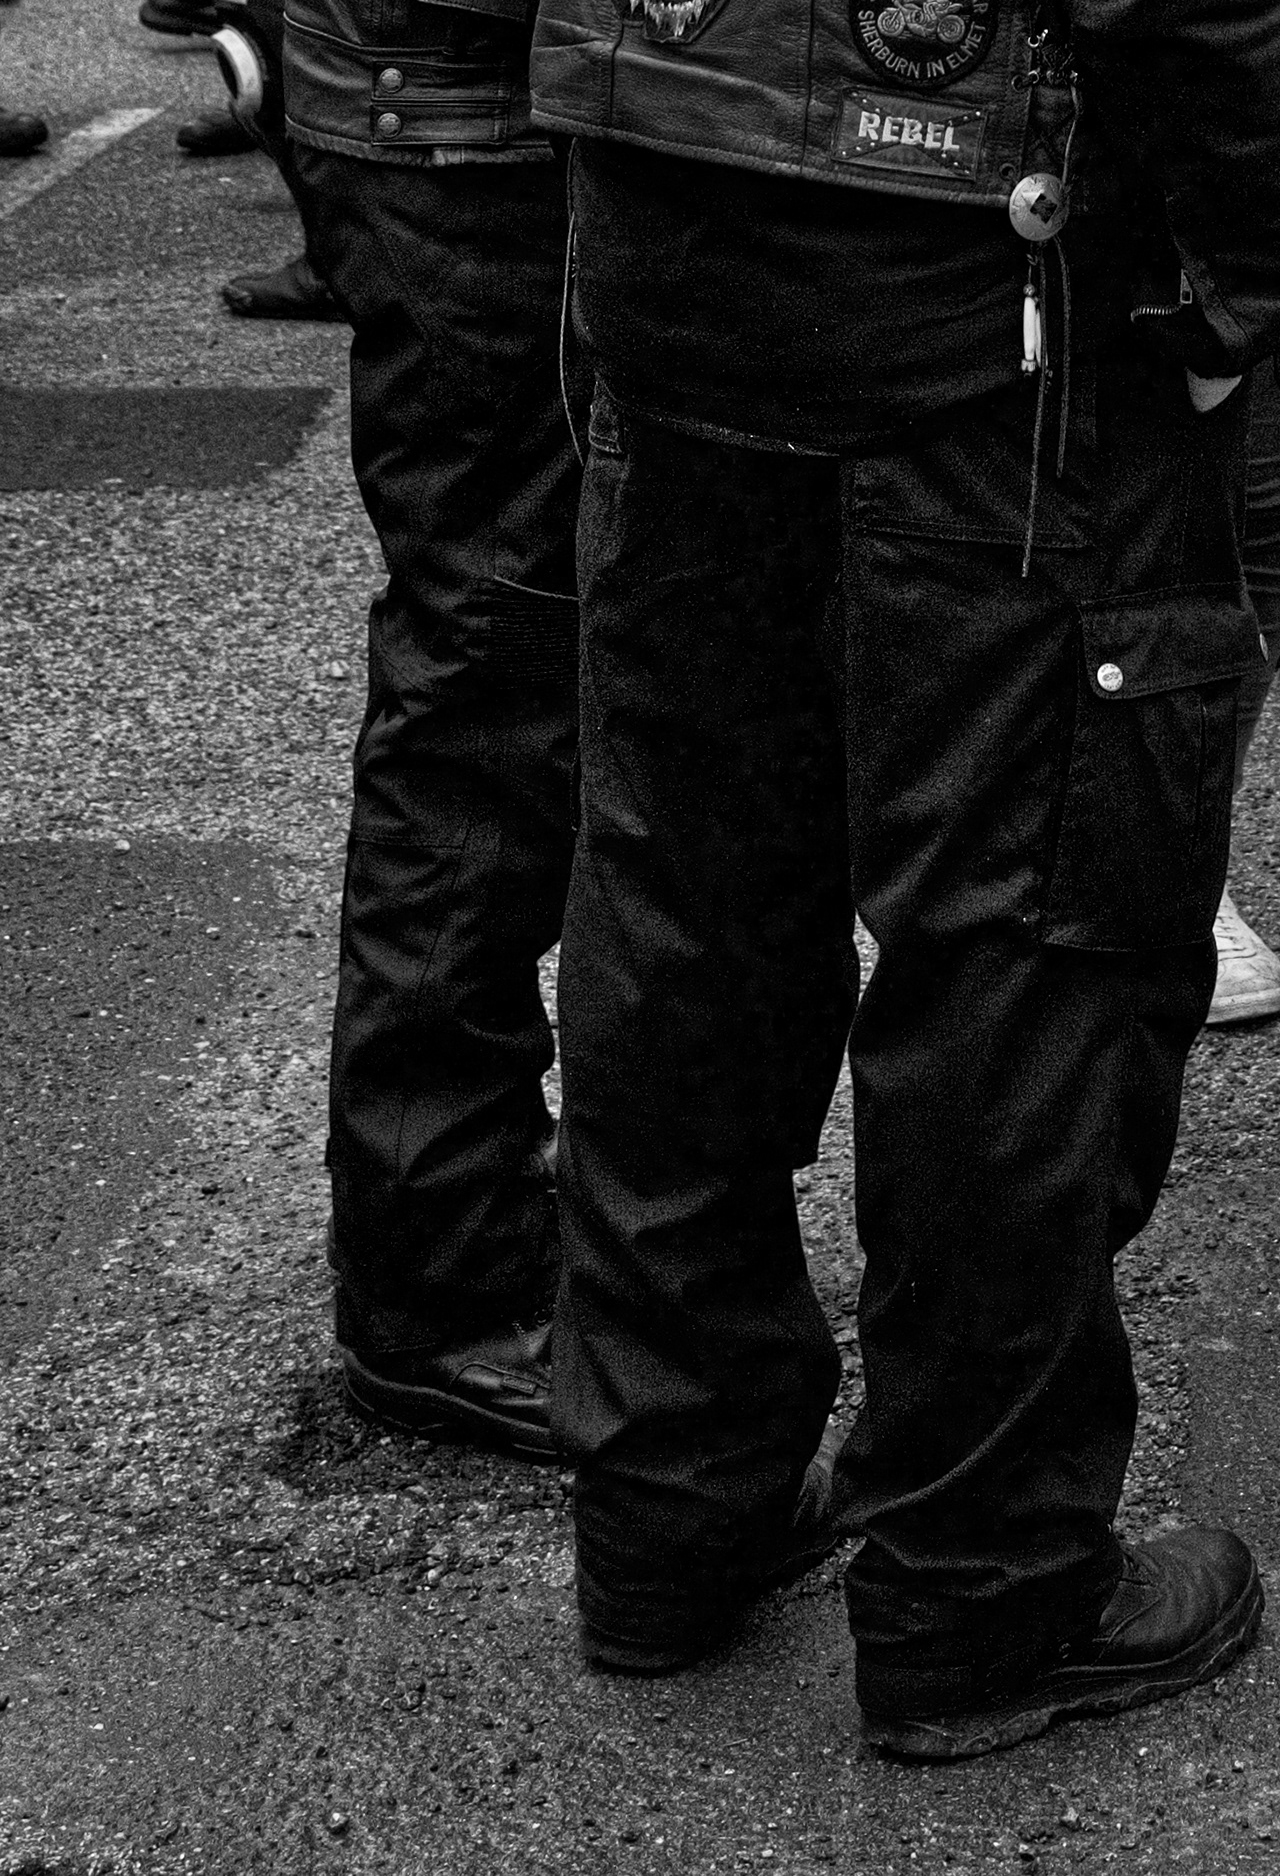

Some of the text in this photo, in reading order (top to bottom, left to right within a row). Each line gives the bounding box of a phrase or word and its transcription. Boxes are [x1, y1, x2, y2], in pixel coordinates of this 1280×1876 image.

[858, 10, 987, 79] SHERBURN IN ELMET
[858, 111, 960, 151] REBEL
